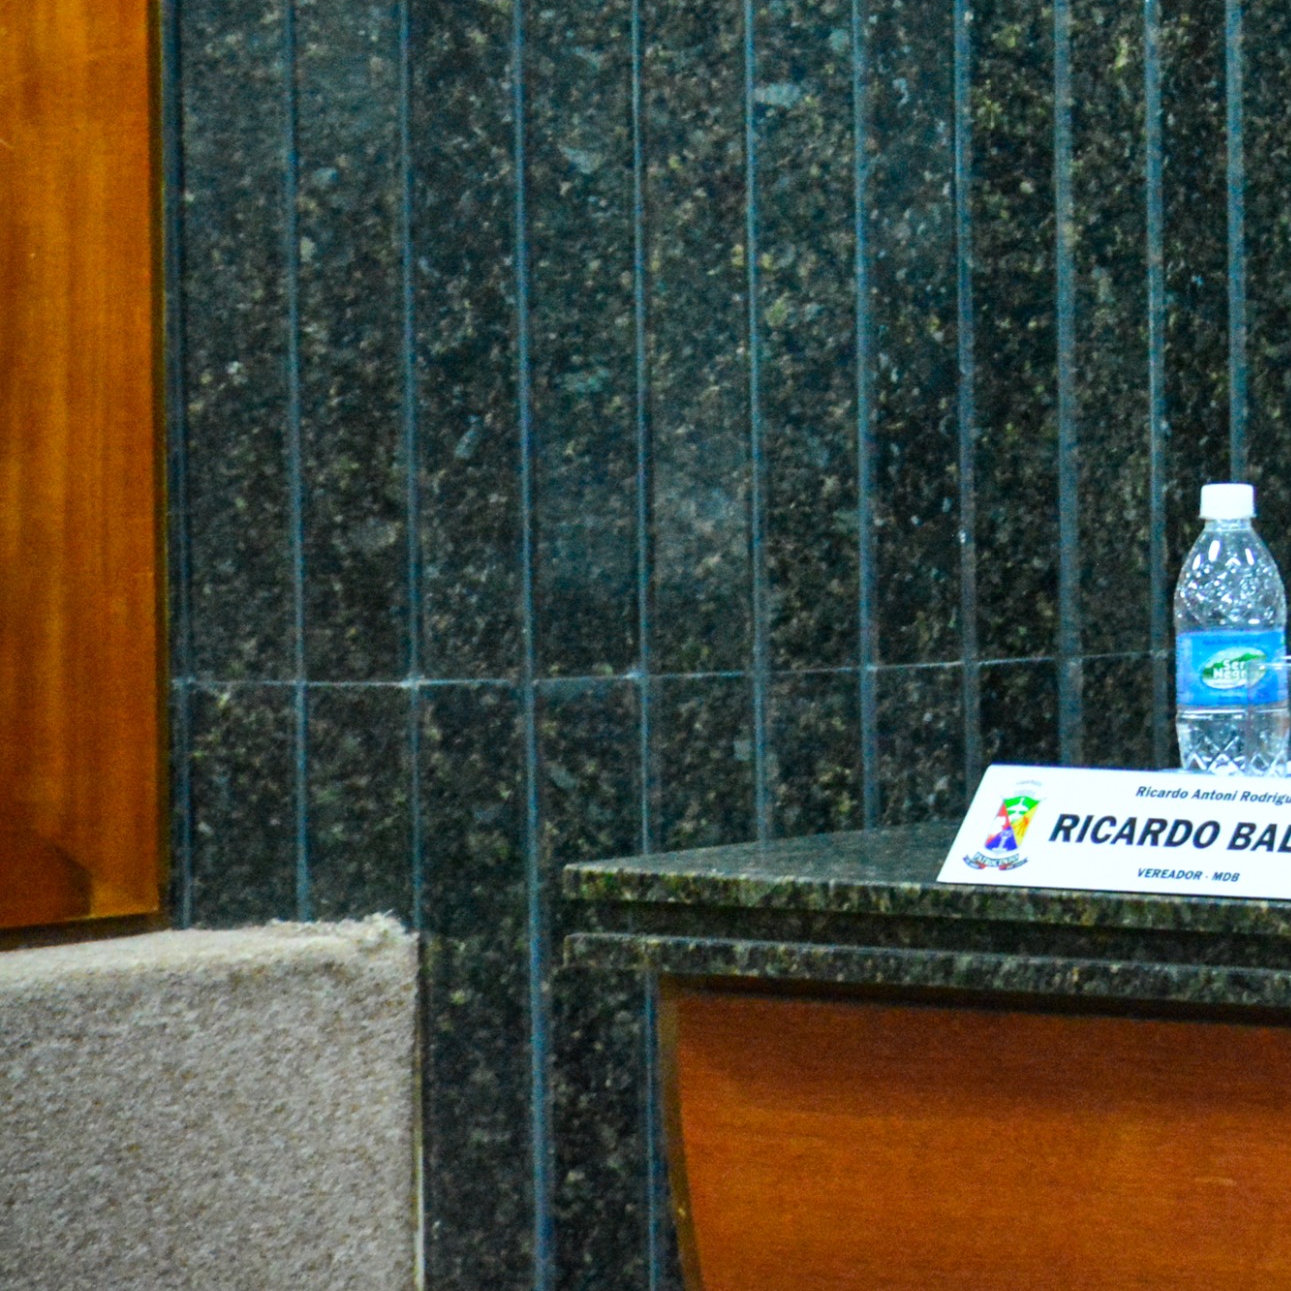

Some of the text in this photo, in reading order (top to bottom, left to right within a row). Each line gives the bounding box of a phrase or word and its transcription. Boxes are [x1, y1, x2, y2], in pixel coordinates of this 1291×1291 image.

[1135, 785, 1189, 800] Ricardo
[1191, 788, 1238, 801] Antoni
[1048, 813, 1221, 850] RICARDO
[1137, 868, 1203, 881] VEREADOR
[1211, 871, 1241, 883] MDB
